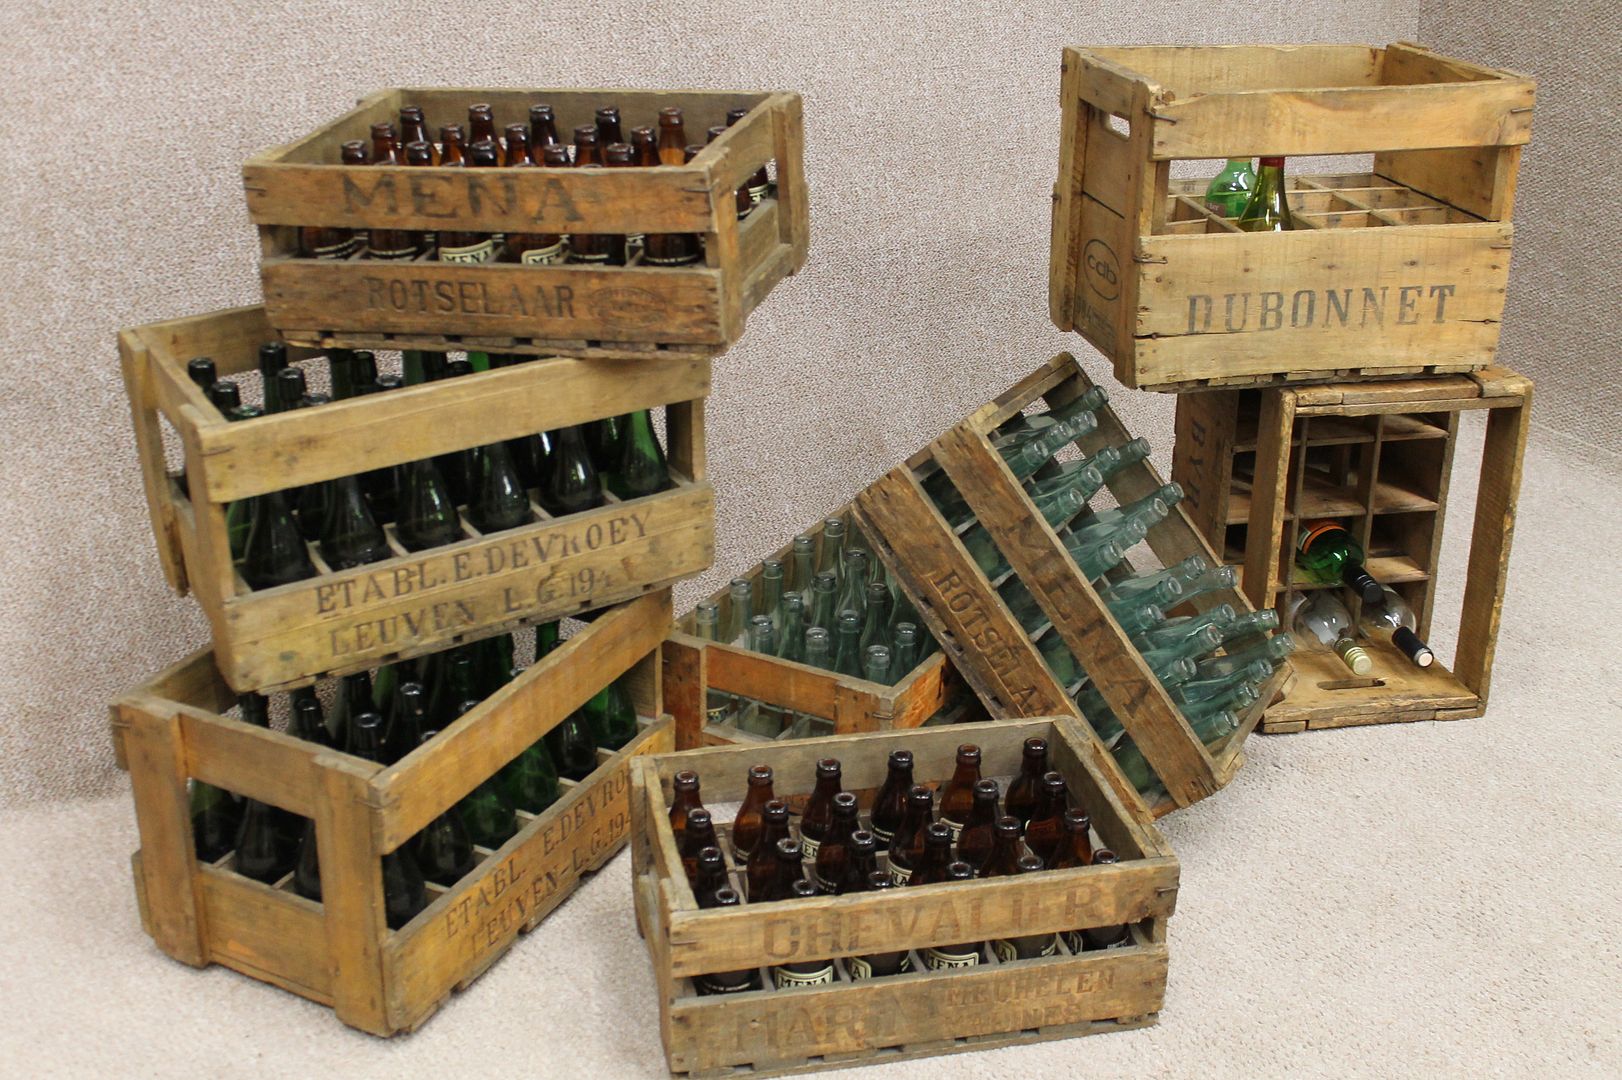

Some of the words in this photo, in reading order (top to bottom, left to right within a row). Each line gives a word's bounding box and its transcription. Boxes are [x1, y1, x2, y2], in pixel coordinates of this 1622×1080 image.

[342, 172, 585, 222] MENA
[366, 277, 576, 319] ROTSELAAR
[1188, 284, 1456, 335] DUBONNET
[329, 597, 477, 657] LEUVEN
[762, 884, 1101, 960] CHEVALIER
